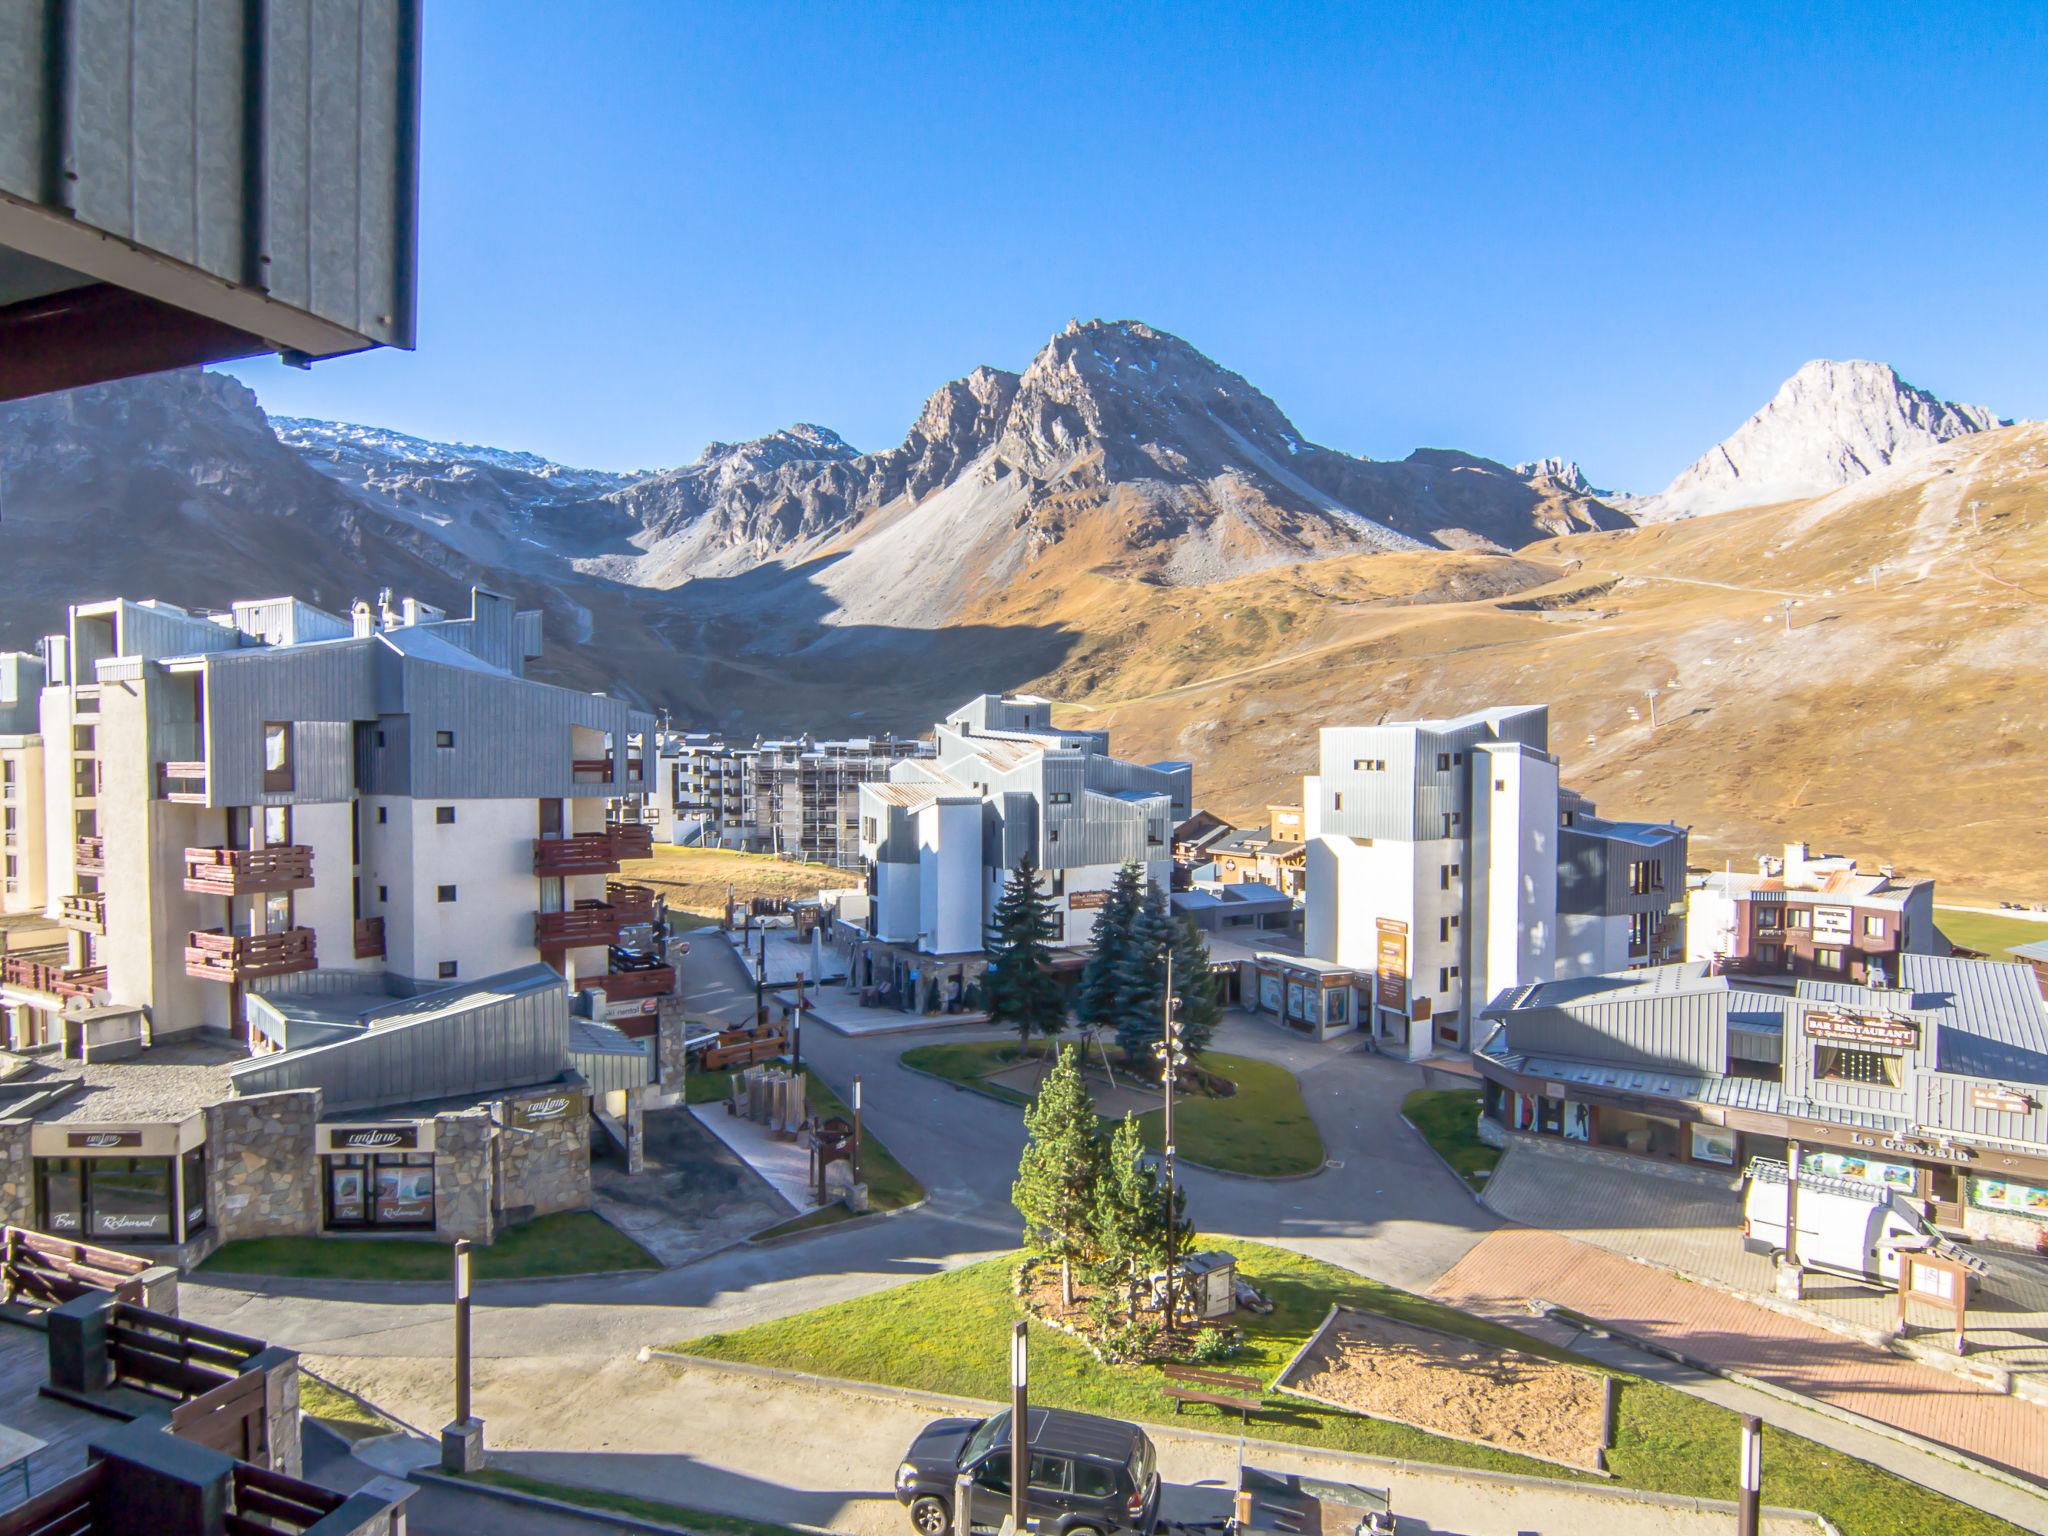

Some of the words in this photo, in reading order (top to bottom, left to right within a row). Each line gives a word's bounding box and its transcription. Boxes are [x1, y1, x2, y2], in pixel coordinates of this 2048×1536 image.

[1808, 1020, 1833, 1031] BAR
[1834, 1023, 1912, 1040] RESTAURANT
[1851, 1131, 1876, 1147] Le
[54, 1213, 76, 1228] Bar
[102, 1215, 159, 1230] Restaurant
